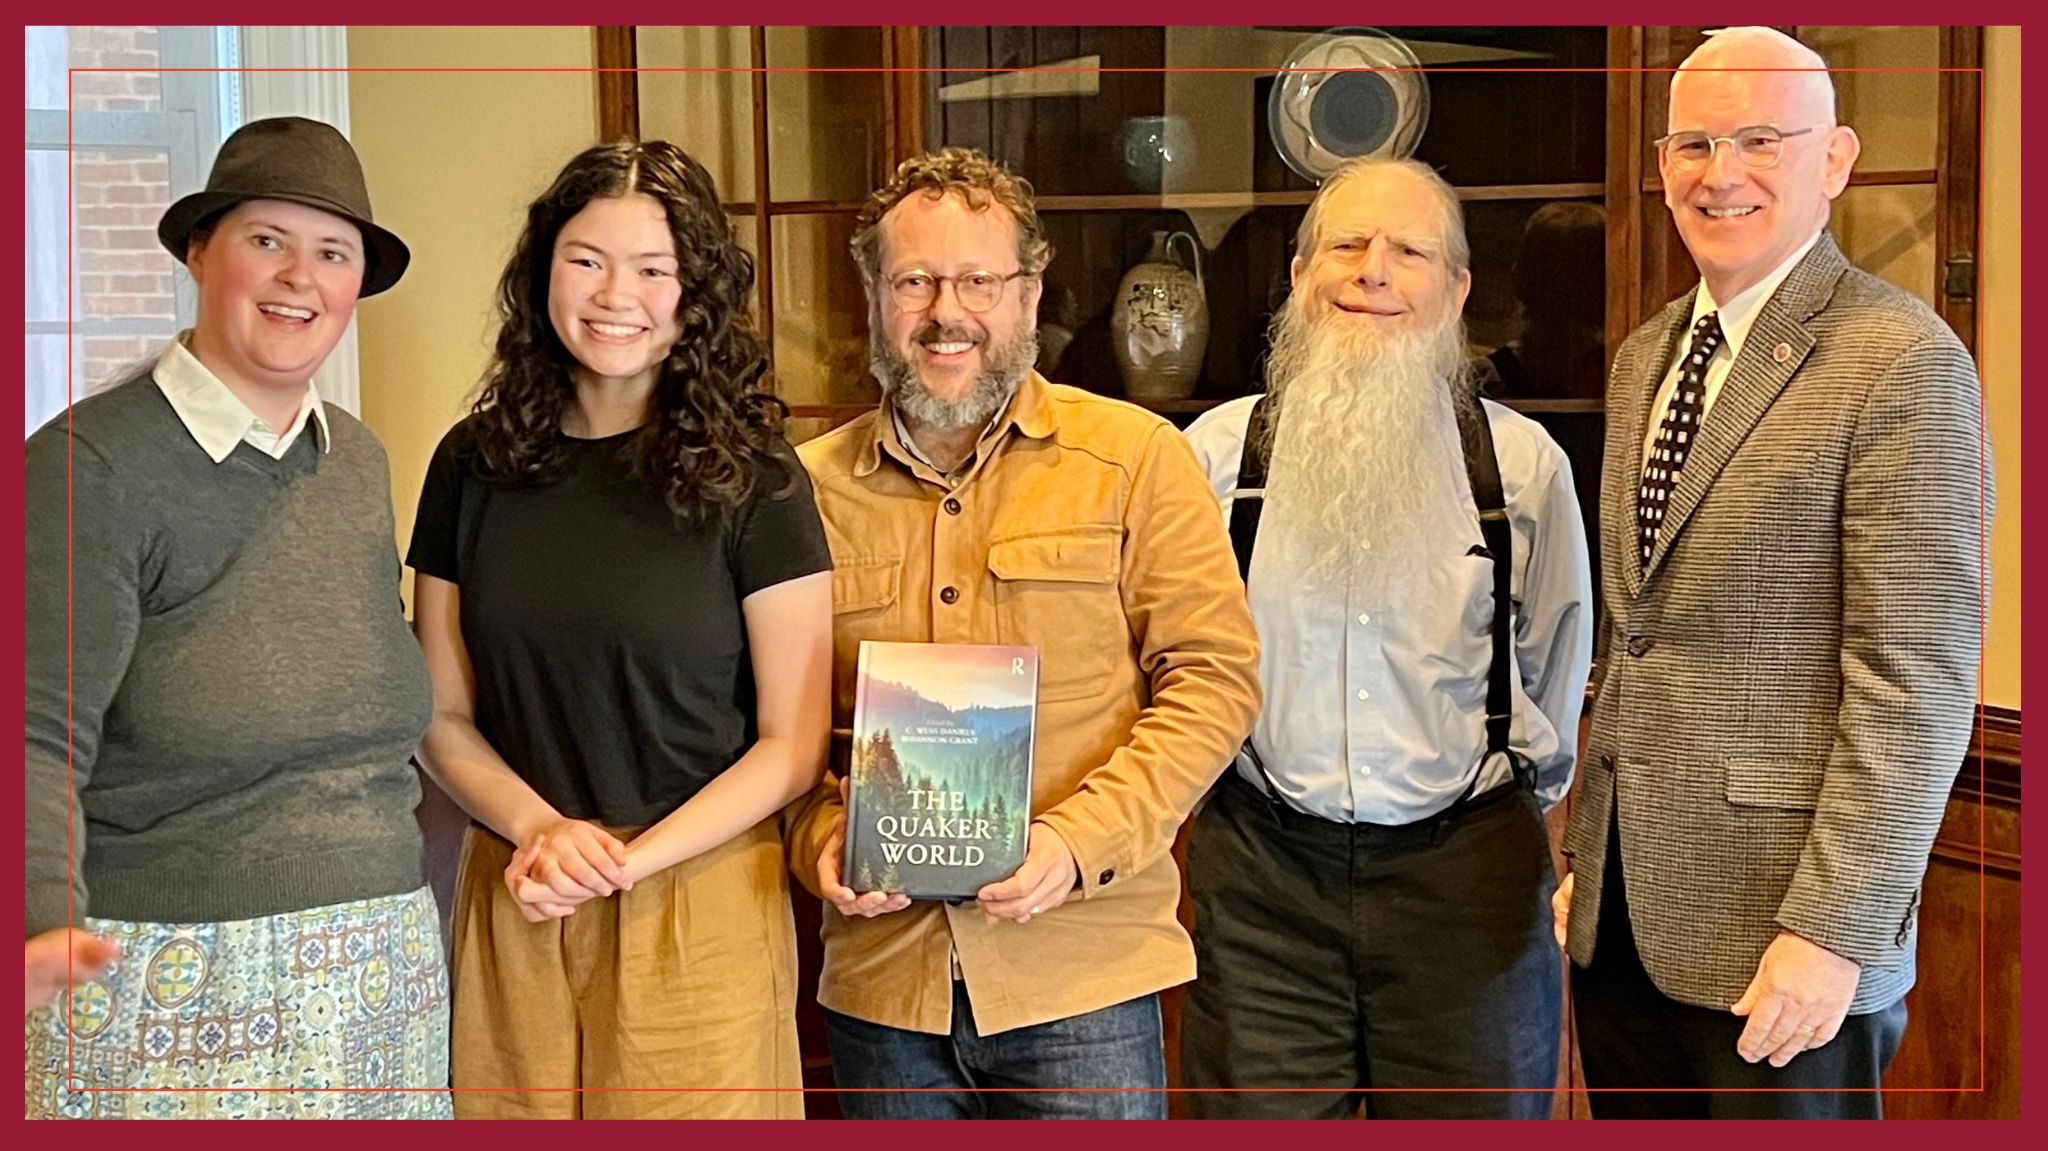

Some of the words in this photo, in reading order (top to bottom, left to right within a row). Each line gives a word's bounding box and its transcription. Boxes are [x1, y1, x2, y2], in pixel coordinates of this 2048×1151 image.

[1011, 656, 1024, 675] R
[949, 736, 978, 745] GRANT
[907, 789, 964, 811] THE
[876, 815, 992, 842] QUAKER
[880, 842, 984, 867] WORLD
